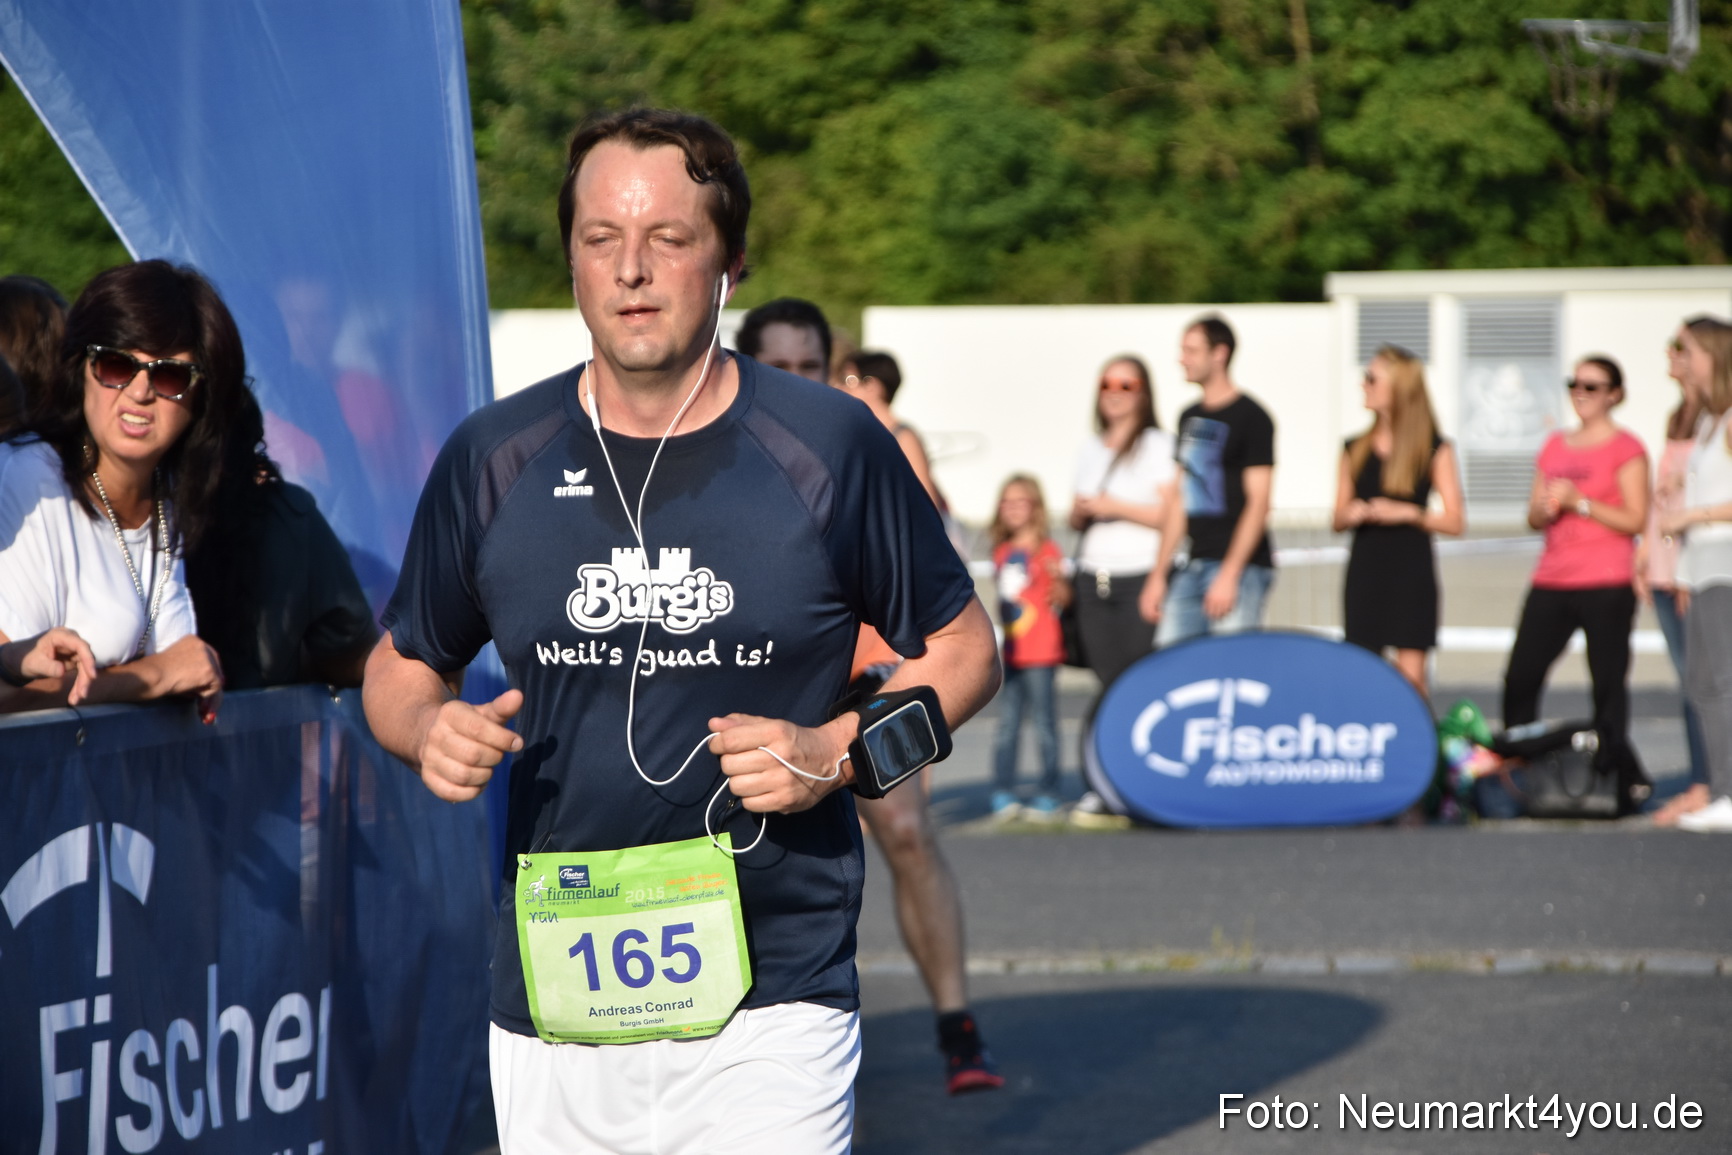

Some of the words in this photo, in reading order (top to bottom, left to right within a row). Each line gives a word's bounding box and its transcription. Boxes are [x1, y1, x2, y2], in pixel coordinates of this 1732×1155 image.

[553, 484, 594, 497] erima
[567, 565, 733, 634] Burgis
[536, 640, 622, 665] Weil's
[638, 639, 721, 676] guad
[735, 640, 773, 665] is!
[1181, 713, 1397, 765] Fischer
[1205, 757, 1384, 787] AUTOMOBILE
[547, 882, 620, 900] firmenlauf
[625, 886, 665, 903] 2015
[568, 921, 702, 991] 165
[588, 1005, 643, 1018] Andreas
[645, 997, 694, 1013] Conrad
[620, 1019, 642, 1028] Burgis
[643, 1017, 665, 1026] GmbH
